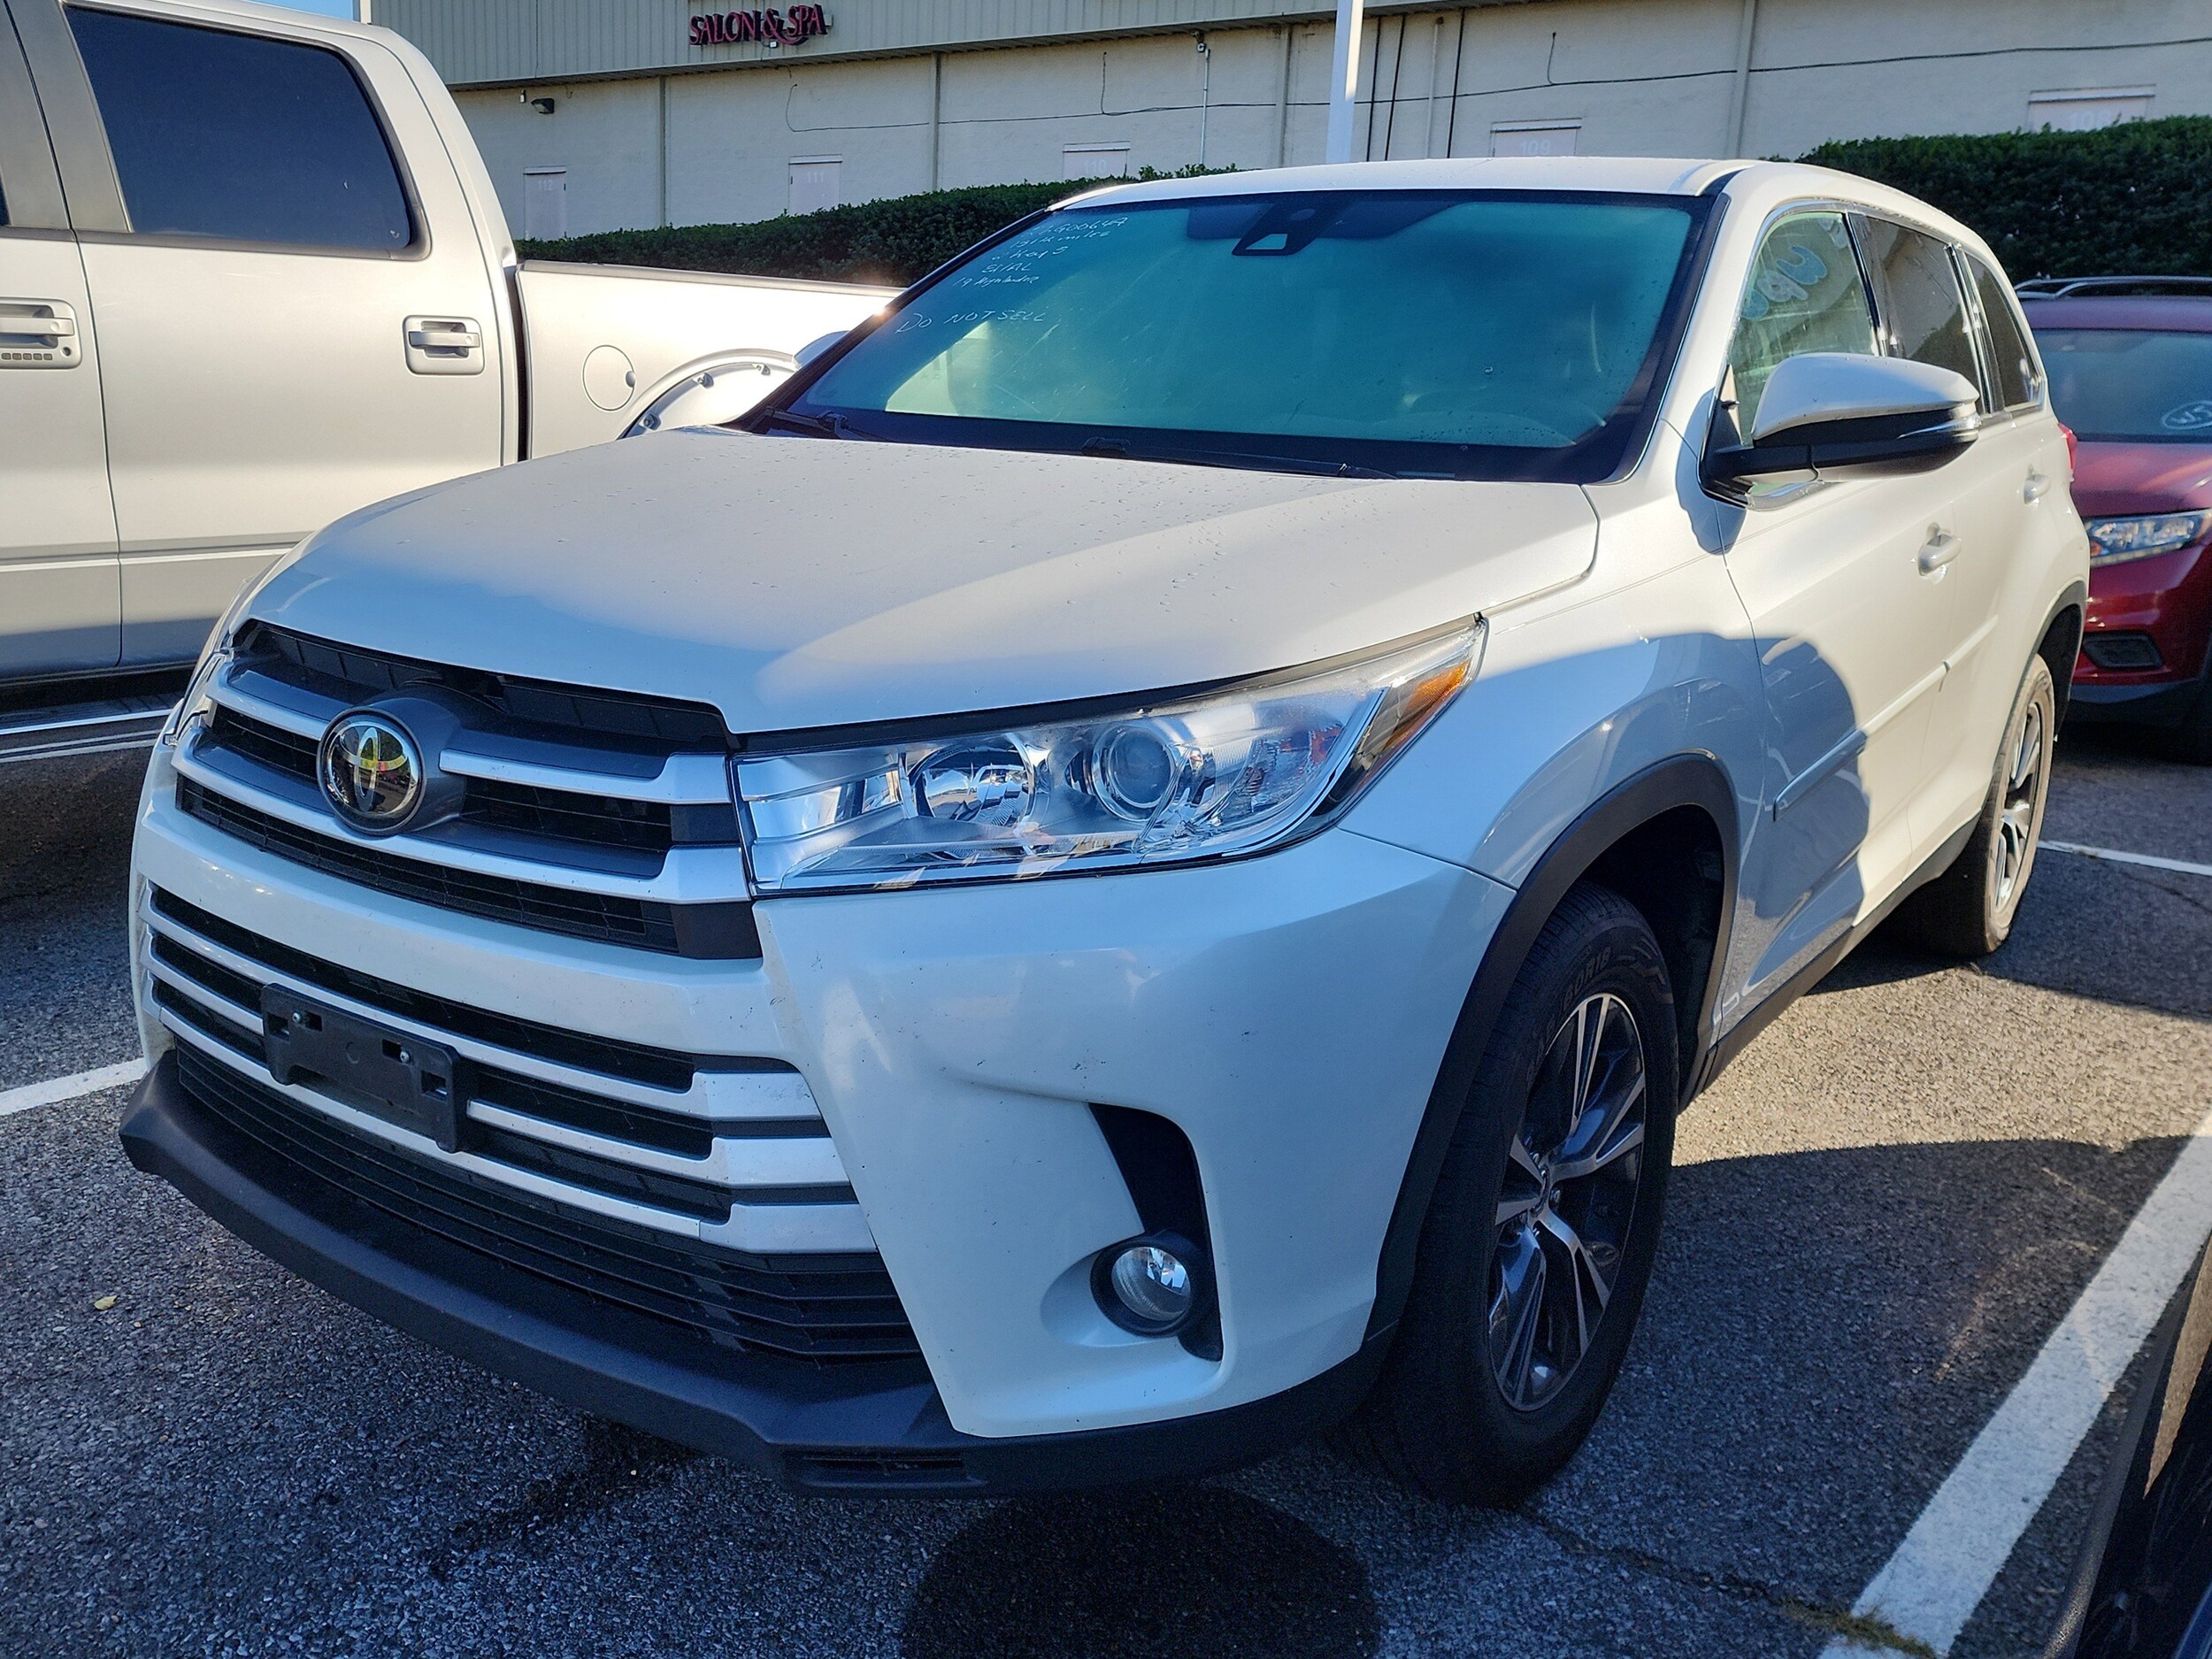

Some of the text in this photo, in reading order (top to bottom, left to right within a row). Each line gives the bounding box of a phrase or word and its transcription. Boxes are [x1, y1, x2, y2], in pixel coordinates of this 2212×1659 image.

[689, 10, 761, 45] SALON
[787, 4, 828, 36] SPA
[1521, 140, 1550, 156] 109
[1083, 158, 1107, 174] 110
[806, 171, 824, 183] 111
[538, 179, 553, 191] 112
[943, 311, 996, 325] NOT
[997, 310, 1047, 323] SELL
